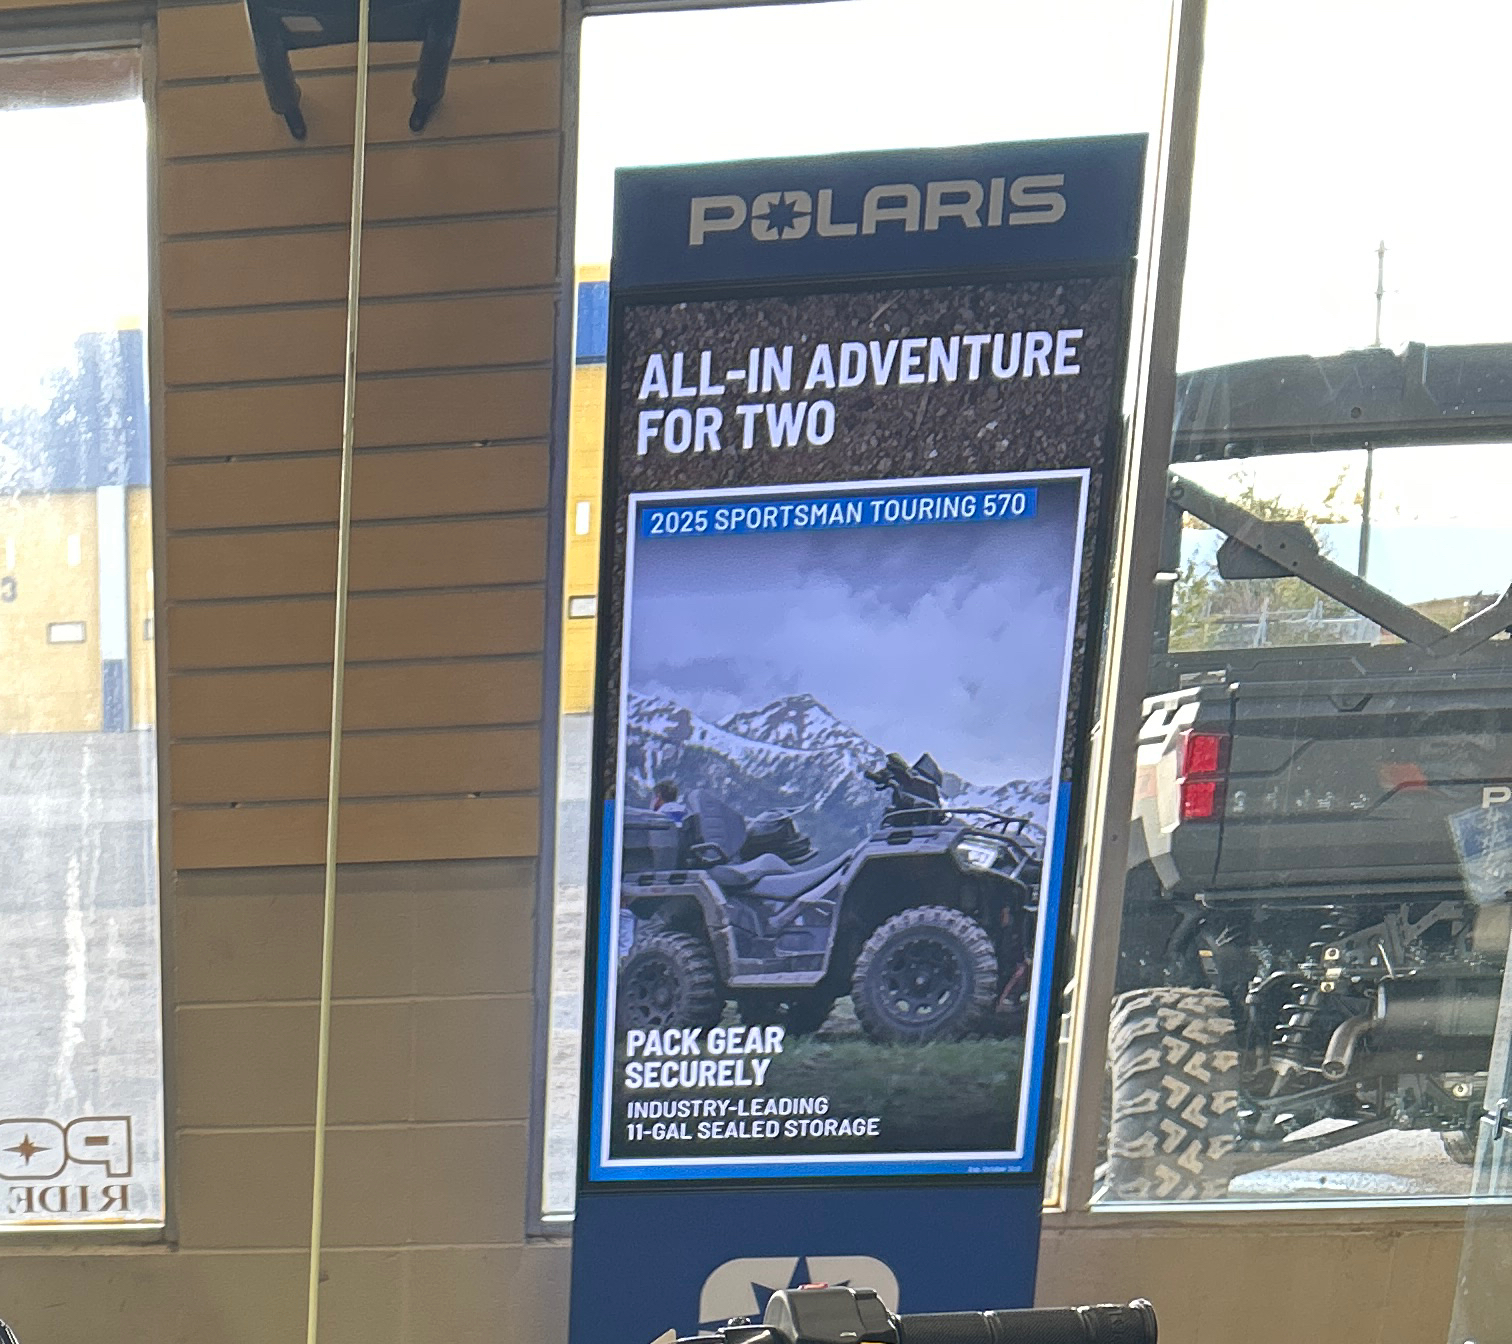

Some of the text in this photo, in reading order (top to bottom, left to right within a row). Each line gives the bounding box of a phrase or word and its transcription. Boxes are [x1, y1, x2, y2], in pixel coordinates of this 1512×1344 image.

[689, 173, 1067, 247] POLARIS
[637, 328, 1084, 401] ALL-IN ADVENTURE
[637, 400, 836, 457] FOR TWO
[650, 493, 1027, 534] 2025 SPORTSMAN TOURING 570
[0, 576, 18, 602] 3
[626, 1026, 785, 1057] PACK GEAR
[625, 1058, 772, 1089] SECURELY
[627, 1097, 829, 1119] INDUSTRY-LEADING
[627, 1118, 881, 1141] 11-GAL SEALED STORAGE
